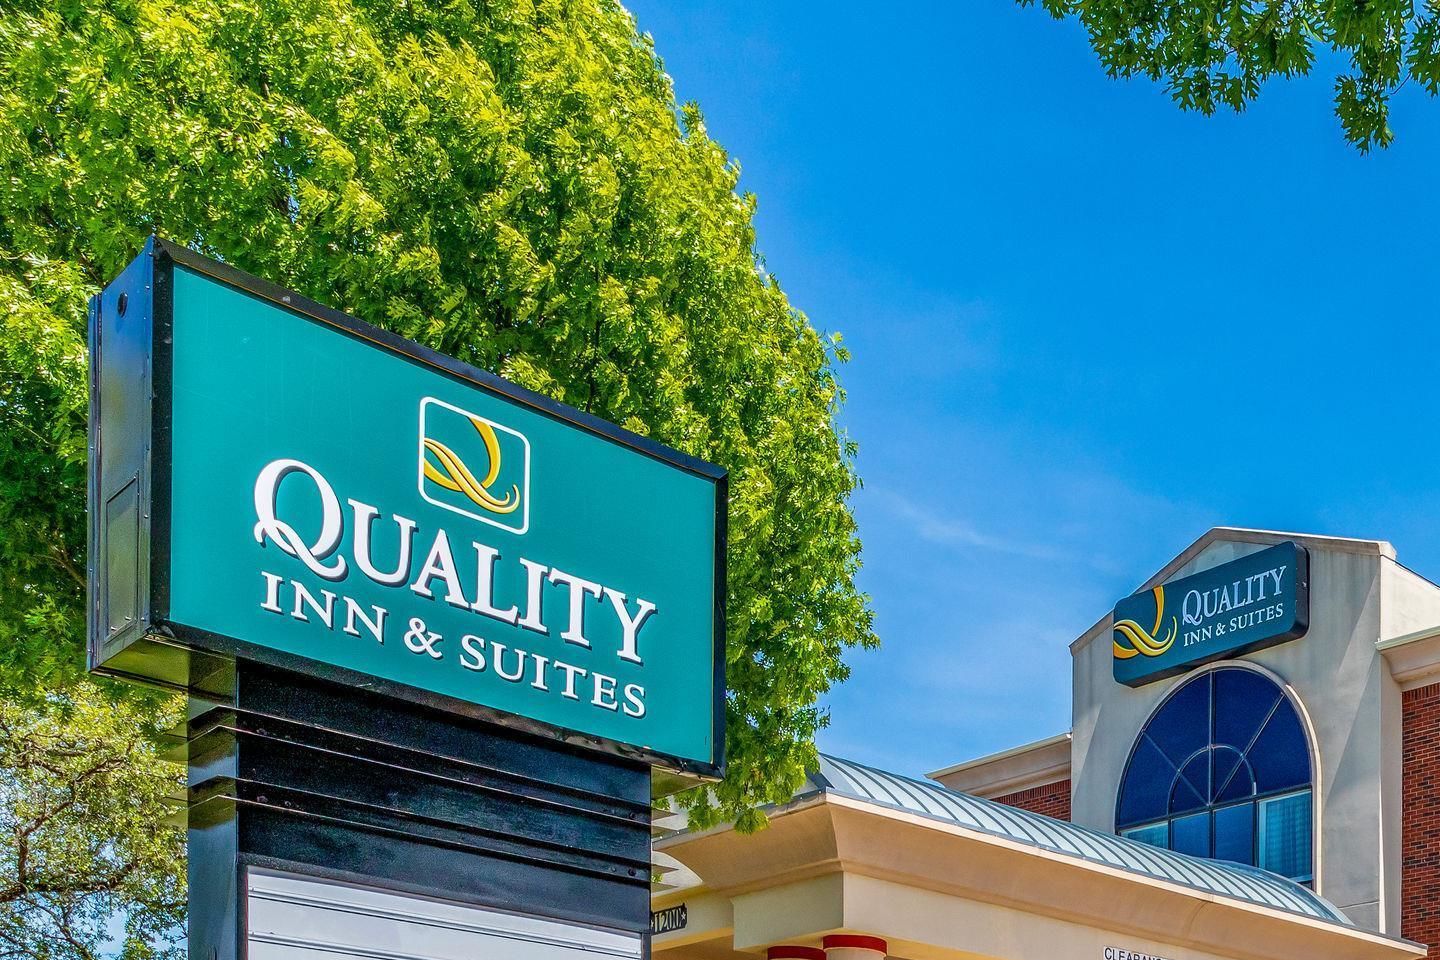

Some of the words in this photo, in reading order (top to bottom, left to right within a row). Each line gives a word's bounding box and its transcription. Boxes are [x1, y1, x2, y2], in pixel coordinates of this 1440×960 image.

[252, 458, 656, 663] QUALITY
[1182, 565, 1287, 626] QUALITY
[260, 571, 388, 643] INN
[403, 617, 443, 659] &
[459, 634, 647, 719] SUITES
[1183, 625, 1213, 647] INN
[1215, 622, 1226, 637] &
[1229, 602, 1284, 633] SUITES
